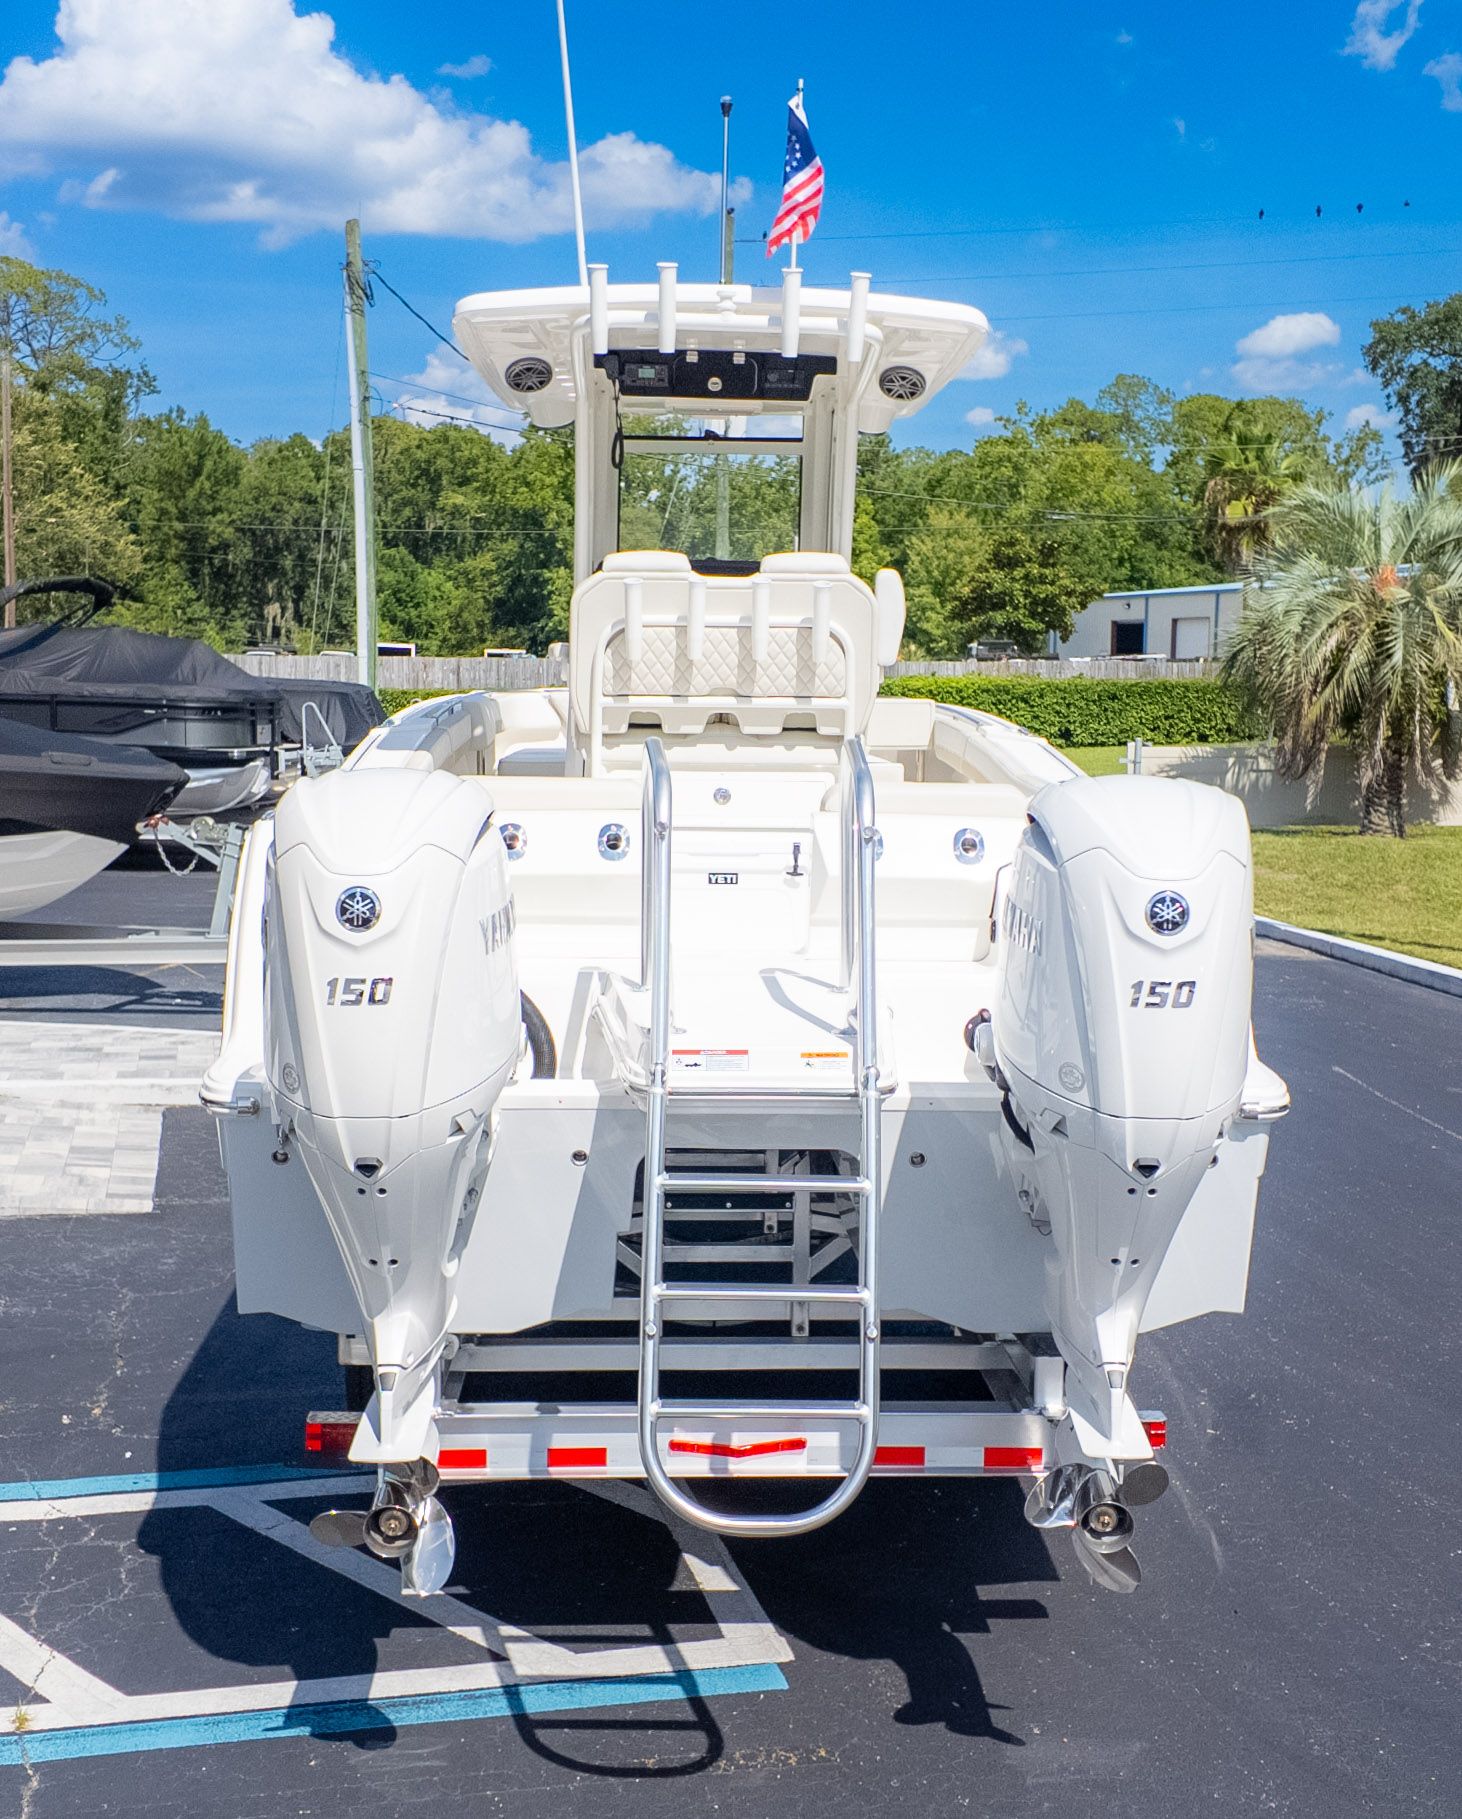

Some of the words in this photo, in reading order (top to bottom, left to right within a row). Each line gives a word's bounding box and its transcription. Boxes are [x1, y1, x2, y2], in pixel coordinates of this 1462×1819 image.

[709, 873, 738, 884] YETI
[326, 977, 393, 1006] 150
[1129, 980, 1196, 1009] 150
